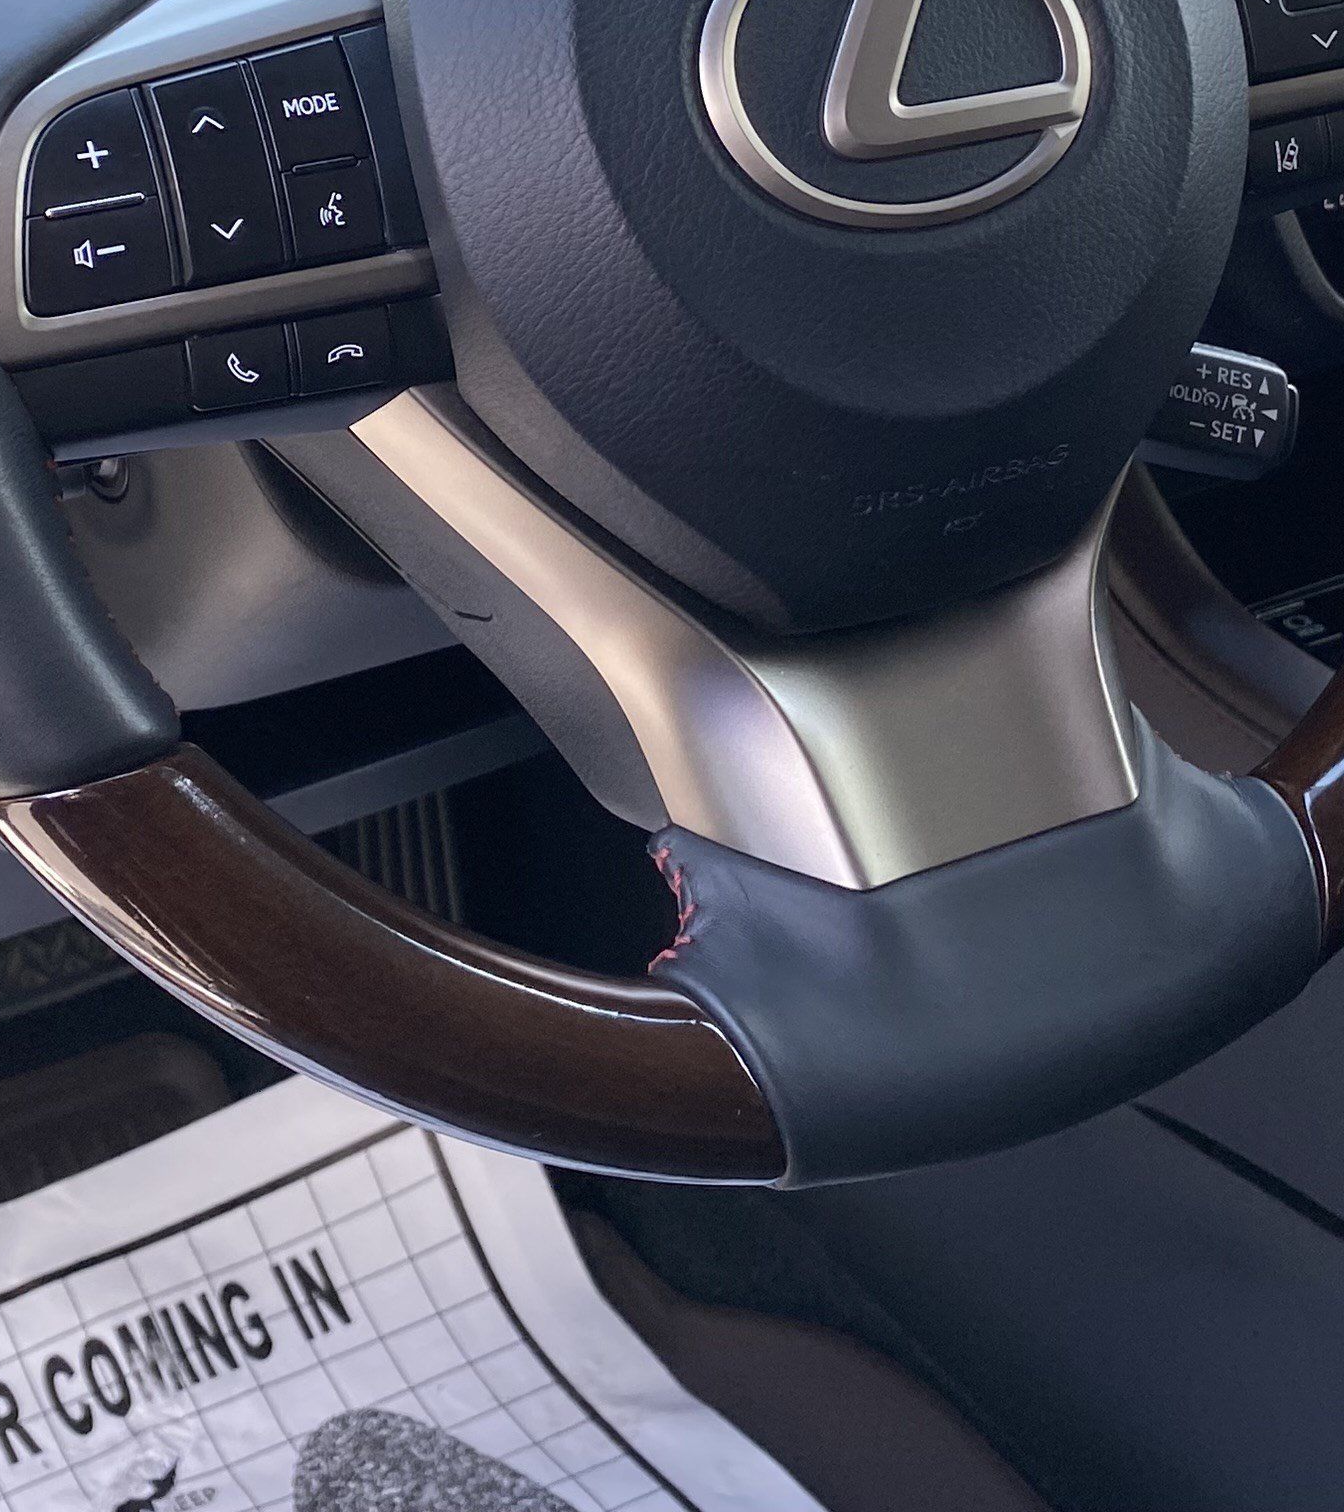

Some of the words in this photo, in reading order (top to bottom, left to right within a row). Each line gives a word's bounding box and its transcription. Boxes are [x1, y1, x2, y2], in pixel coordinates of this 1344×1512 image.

[282, 92, 340, 118] MODE
[1217, 367, 1252, 390] RES
[1210, 420, 1247, 444] SET
[43, 1281, 273, 1436] COMING
[270, 1247, 352, 1341] IN
